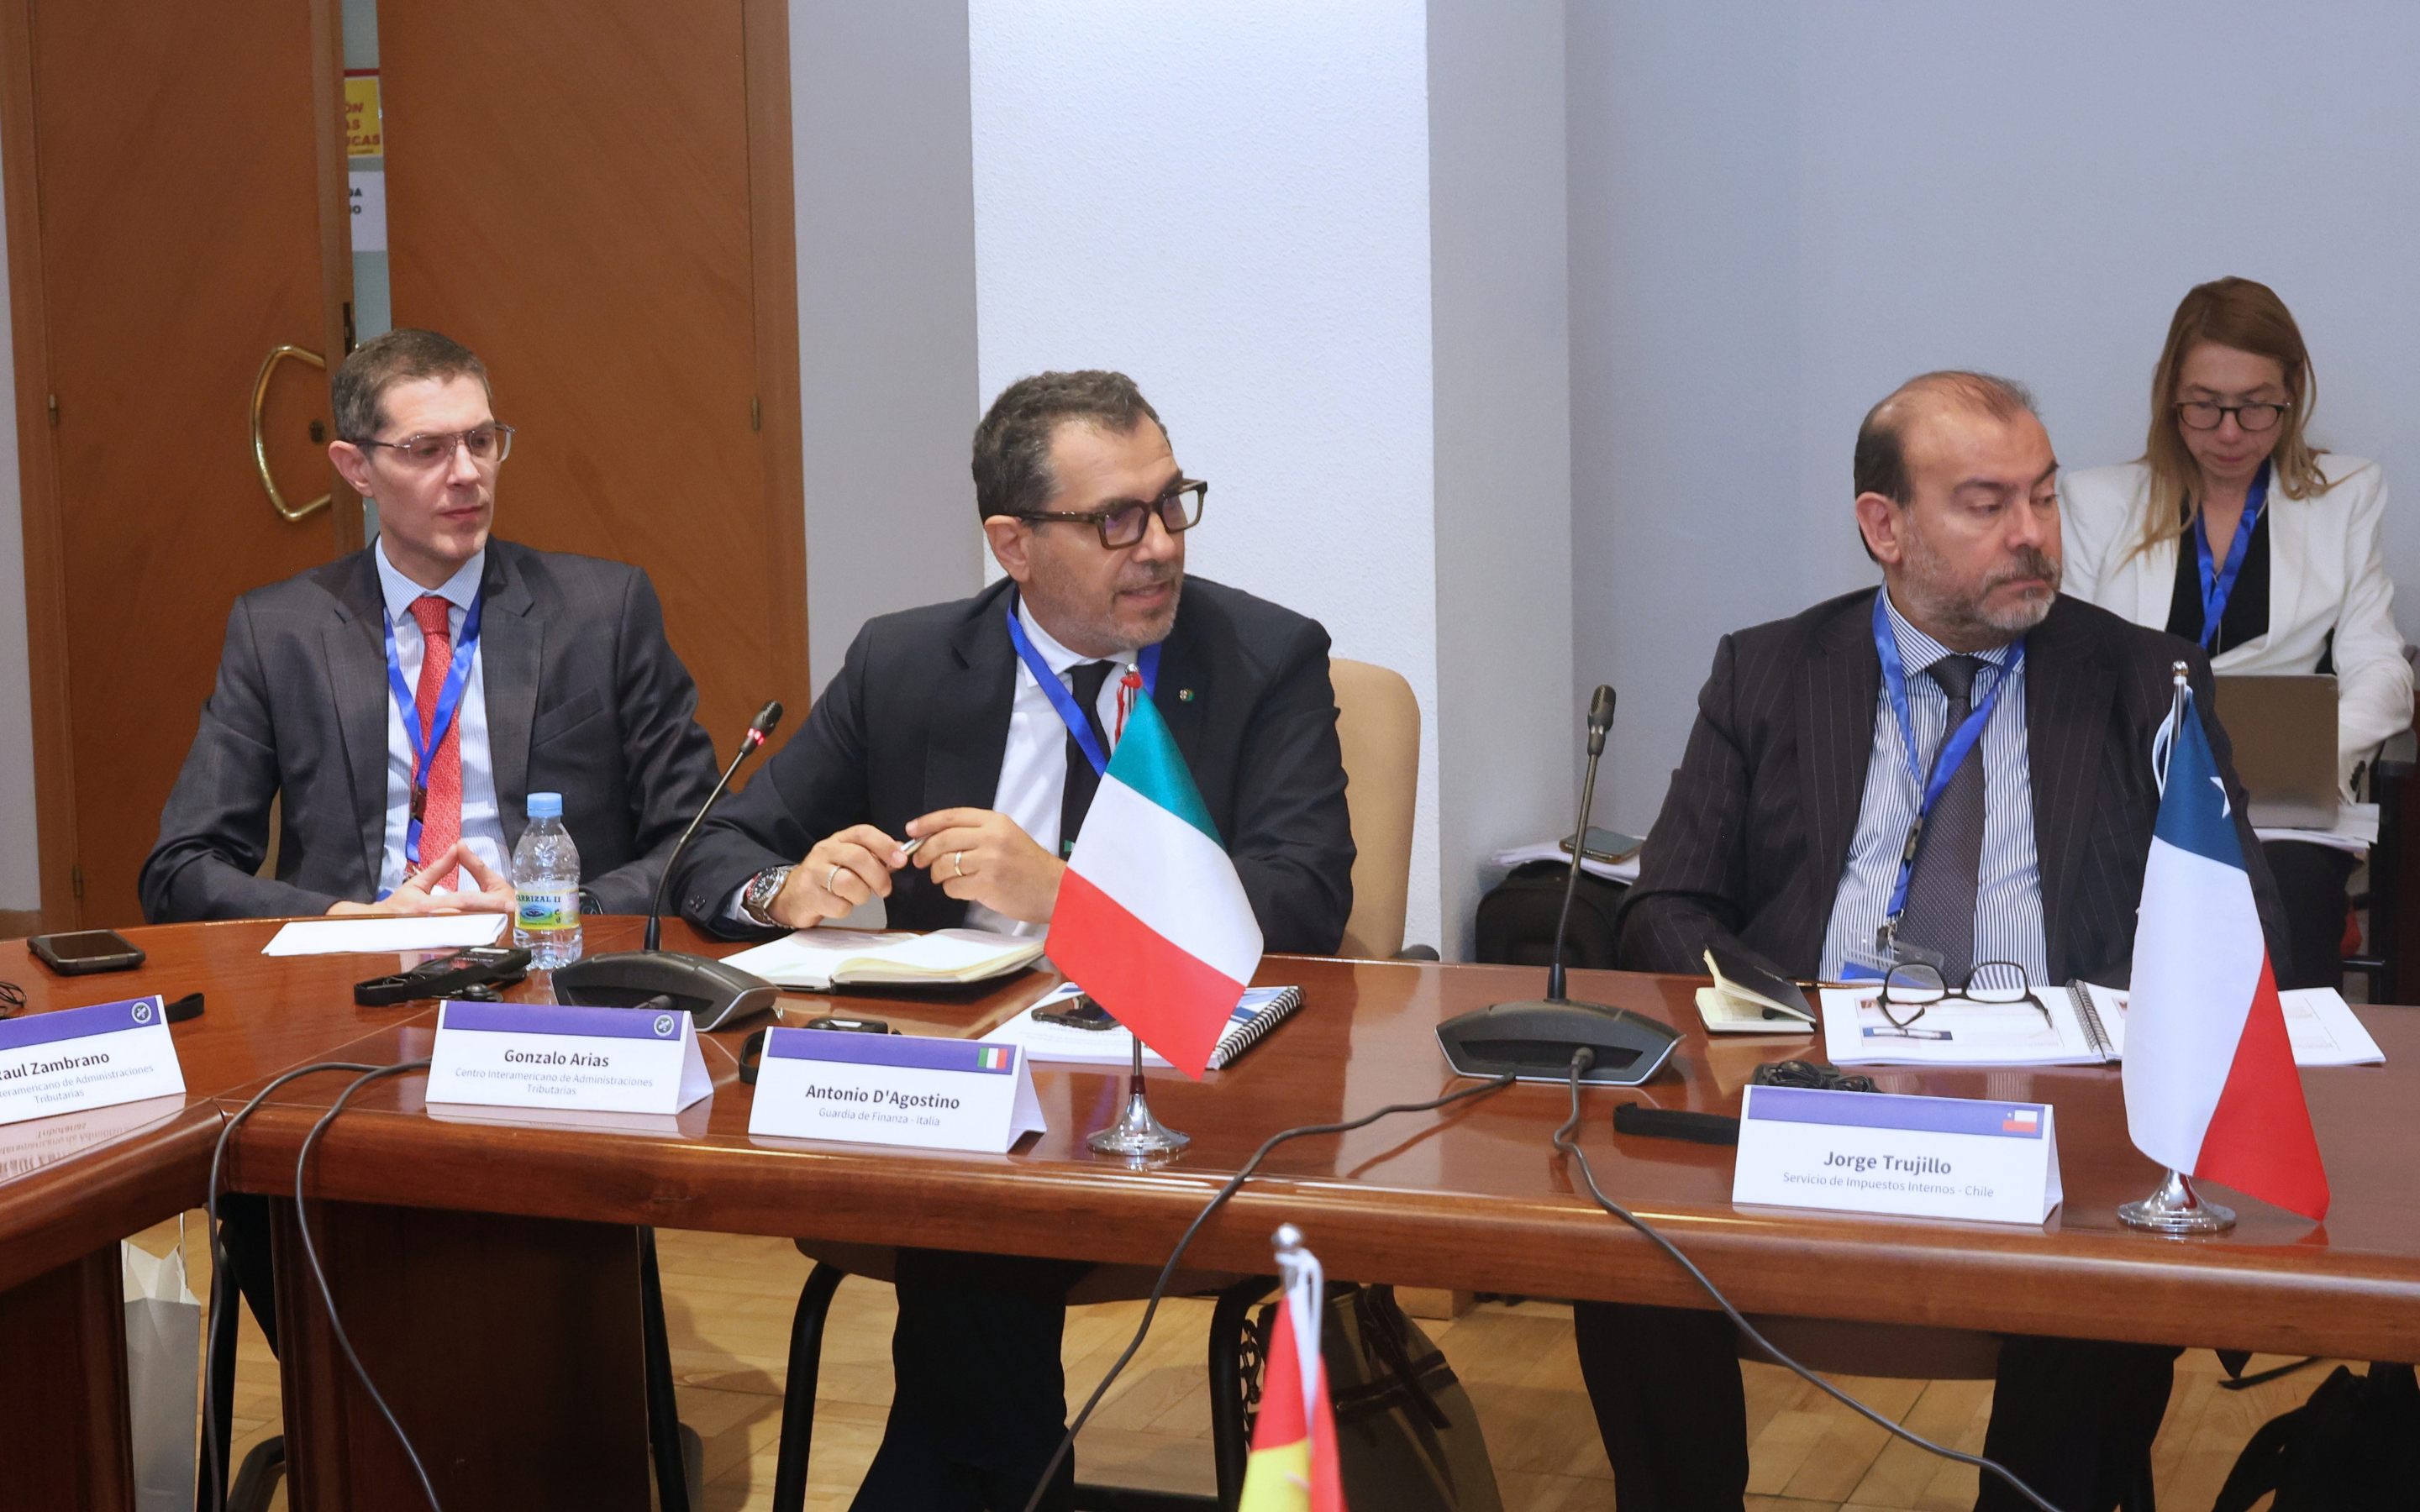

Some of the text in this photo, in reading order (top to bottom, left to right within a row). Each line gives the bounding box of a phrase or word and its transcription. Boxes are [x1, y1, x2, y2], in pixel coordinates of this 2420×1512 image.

[30, 1053, 110, 1075] Zambrano
[504, 1049, 609, 1068] Gonzalo Arias
[62, 1078, 74, 1087] de
[76, 1064, 154, 1084] Administraciones
[455, 1068, 653, 1087] Centro Interamericano de Administraciones
[34, 1089, 85, 1105] Tributarias
[527, 1084, 576, 1095] Tributarias
[805, 1084, 960, 1110] Antonio D'Agostino
[818, 1107, 855, 1121] Guardia
[858, 1110, 870, 1121] de
[871, 1111, 908, 1124] Finanza
[916, 1116, 940, 1126] Italia
[1823, 1150, 1952, 1176] Jorge Trujillo
[1783, 1172, 1827, 1186] Servicio
[1829, 1175, 1844, 1186] de
[1846, 1177, 1906, 1192] Impuestos
[1908, 1181, 1955, 1194] Internos
[1965, 1185, 1994, 1198] Chile
